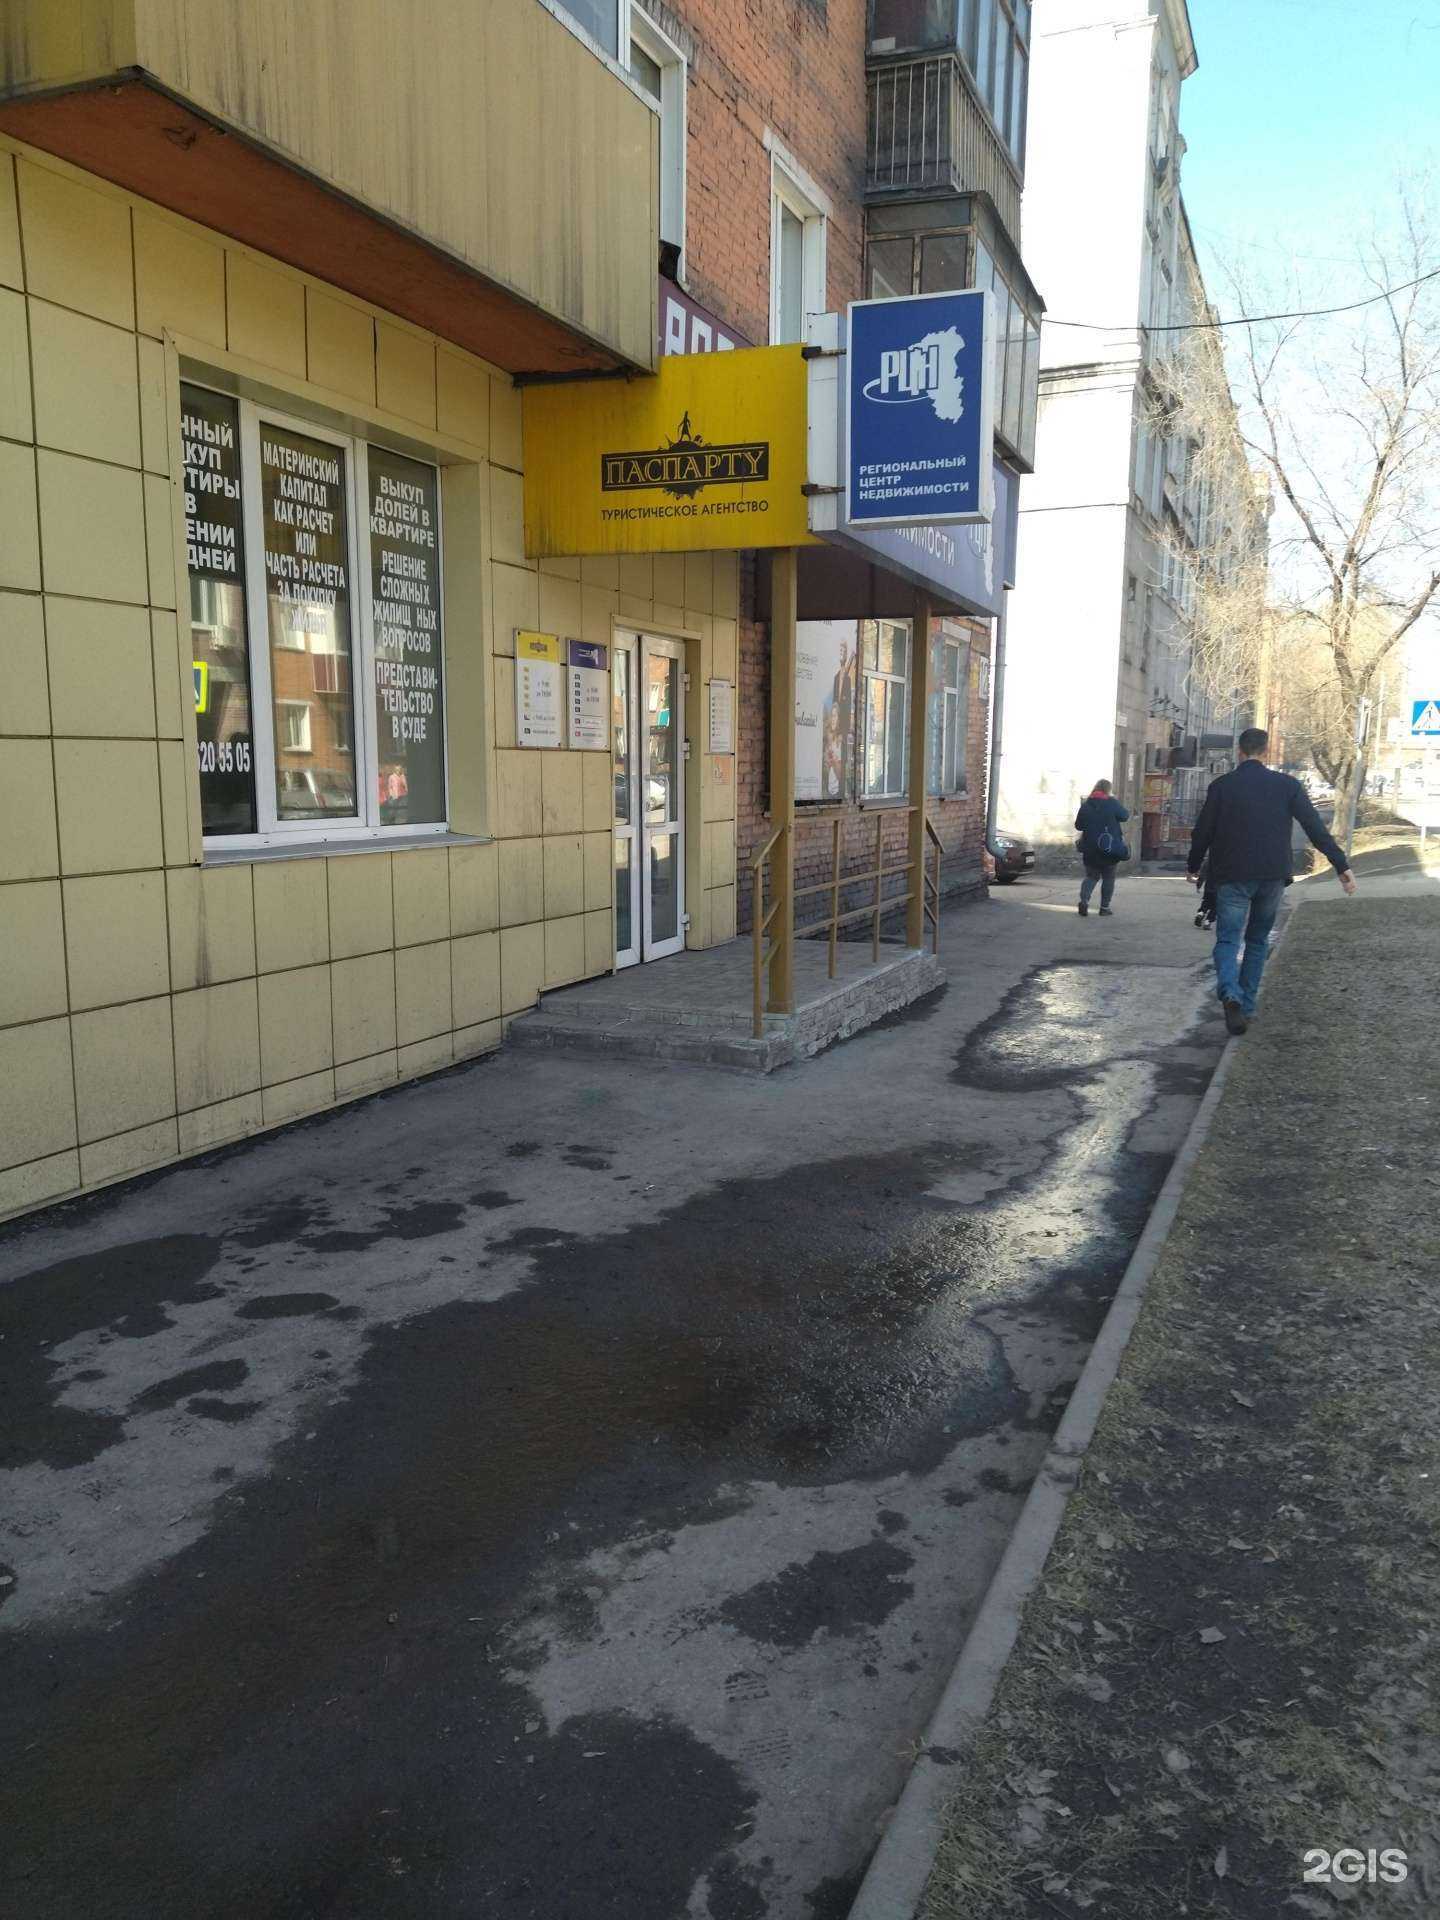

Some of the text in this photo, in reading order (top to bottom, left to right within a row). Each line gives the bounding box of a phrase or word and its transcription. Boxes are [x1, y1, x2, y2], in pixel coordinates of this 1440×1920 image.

[181, 440, 222, 470] КУП
[263, 441, 339, 485] МАТЕРИНСКИЙ
[859, 455, 967, 475] РЕГИОНАЛЬНЫЙ
[280, 474, 327, 507] КАПИТАЛ
[380, 476, 424, 505] ВЫКУП
[859, 475, 901, 488] ЦЕНТР
[859, 482, 969, 501] НЕДВИЖИМОСТИ
[185, 492, 197, 514] В
[274, 499, 334, 535] КАК РАСЧЕТ
[375, 496, 430, 527] ДОЛЕЙ В
[601, 500, 769, 521] ТУРИСТИЧЕСКОЕ АГЕНТСТВО
[295, 531, 317, 557] ИЛИ
[370, 515, 435, 548] КВАРТИРЕ
[187, 544, 236, 572] ДНЕЙ
[266, 551, 346, 589] ЧАСТЬ РАСЧЕТА
[382, 550, 427, 580] РЕШЕНИЕ
[278, 580, 291, 601] ЗА
[380, 575, 431, 605] СЛОЖНЫХ
[382, 627, 431, 653] ВОПРОСОВ
[376, 661, 438, 690] ПРЕДСТАВИ-
[381, 688, 434, 714] ТЕЛЬСТВО
[392, 715, 427, 743] В СУДЕ
[219, 742, 233, 772] 55
[236, 742, 250, 772] 05
